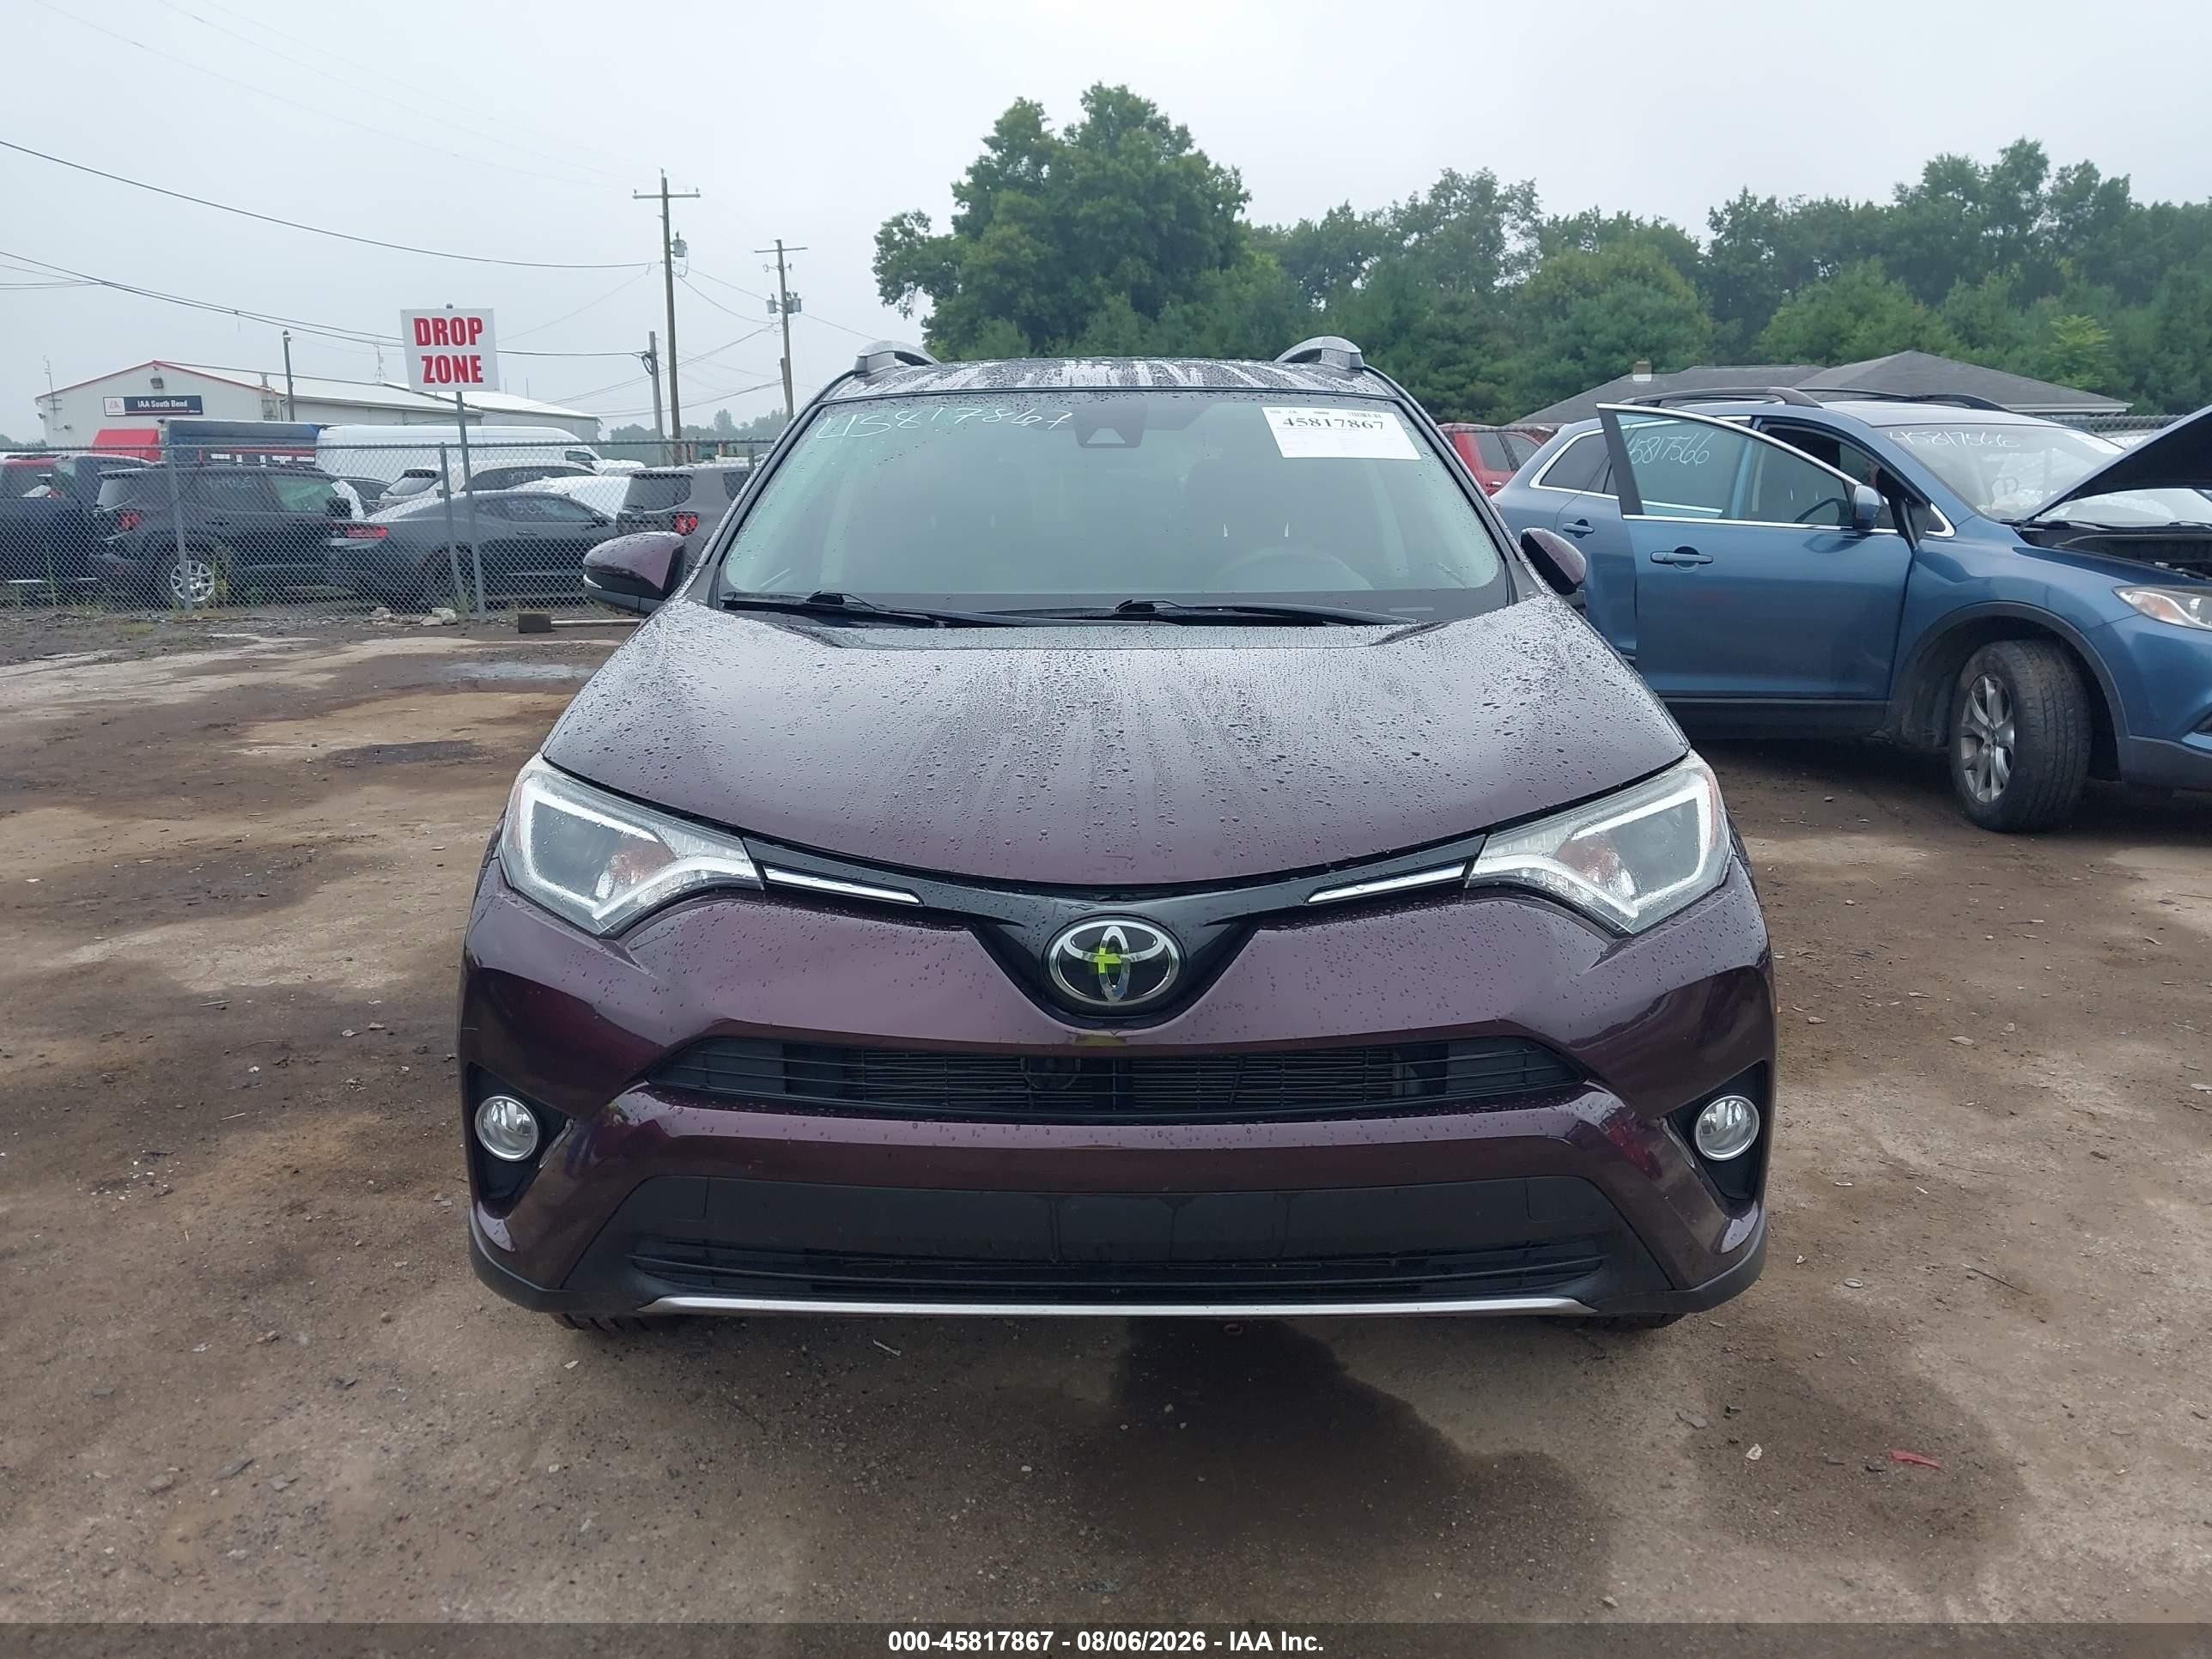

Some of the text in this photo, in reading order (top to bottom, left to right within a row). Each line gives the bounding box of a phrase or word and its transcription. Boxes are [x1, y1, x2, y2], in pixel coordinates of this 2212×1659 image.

[413, 316, 483, 346] DROP
[421, 355, 483, 384] ZONE
[1283, 417, 1383, 430] 45817867
